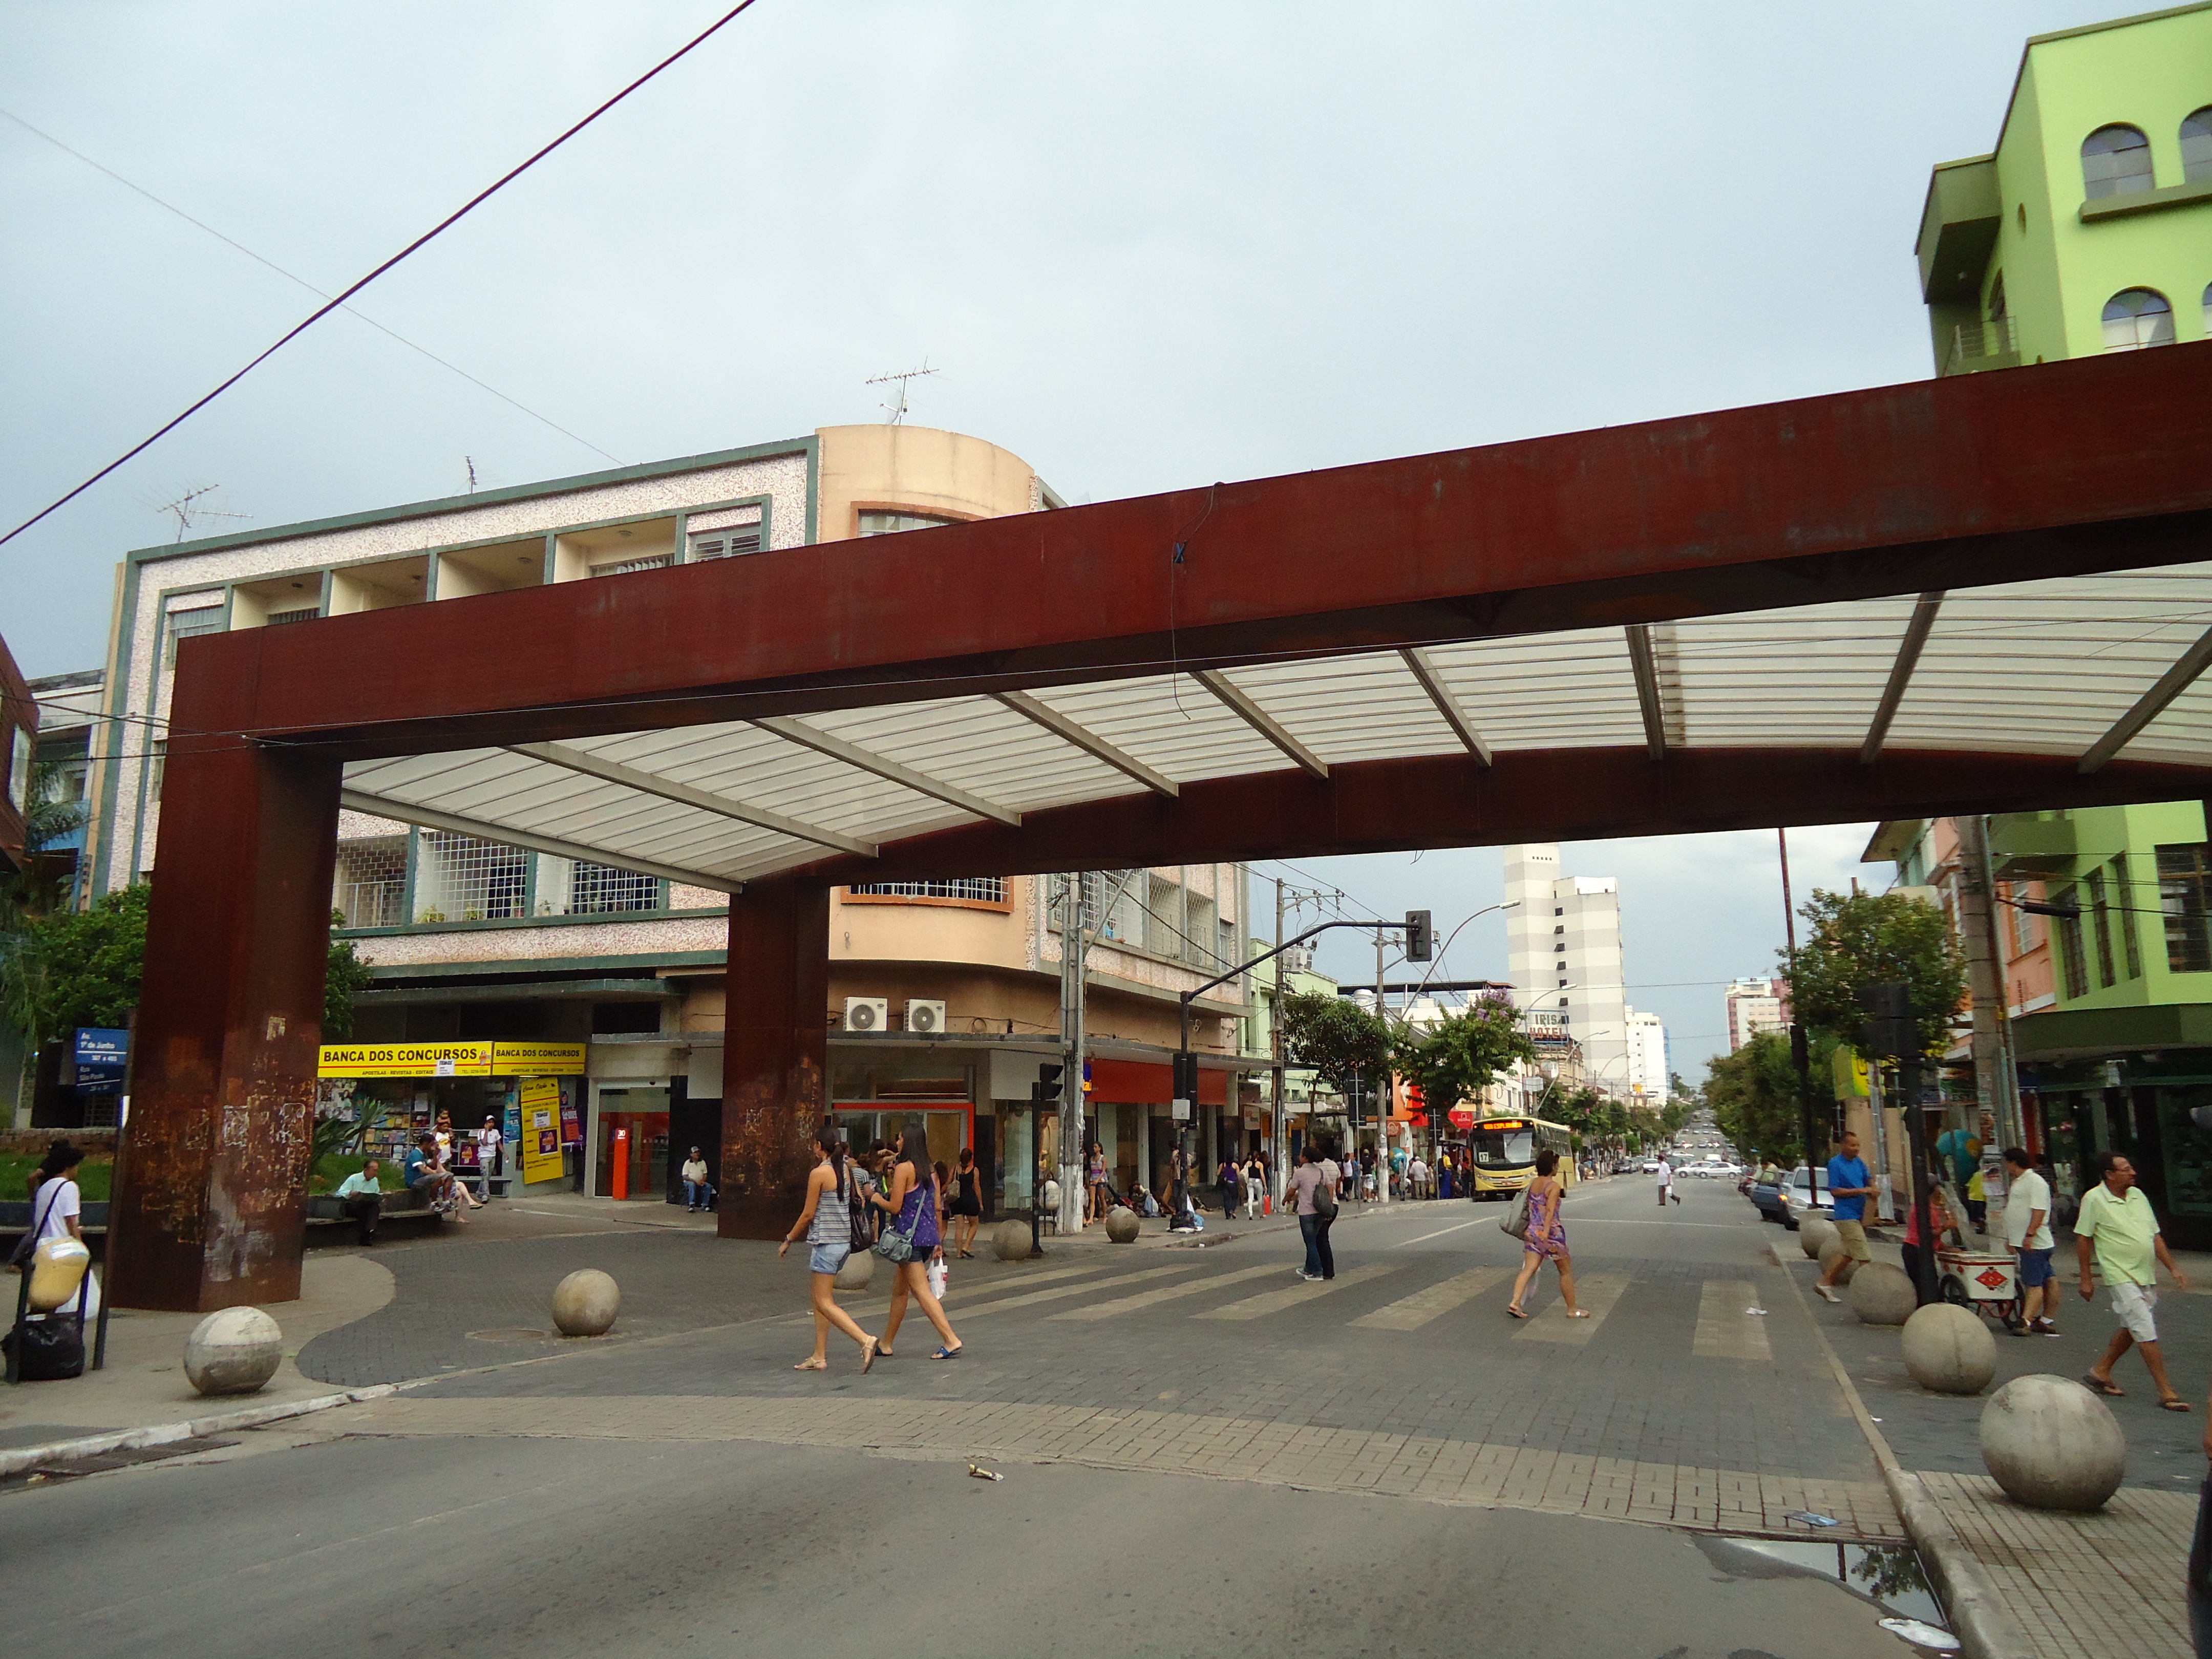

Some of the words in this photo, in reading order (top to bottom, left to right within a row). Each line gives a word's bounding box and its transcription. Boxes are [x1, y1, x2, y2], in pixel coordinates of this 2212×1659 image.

[1535, 1014, 1557, 1026] IRIS
[1529, 1027, 1566, 1038] HOTEL
[324, 1051, 365, 1062] BANCA
[369, 1050, 393, 1061] DOS
[397, 1049, 477, 1060] CONCURSOS
